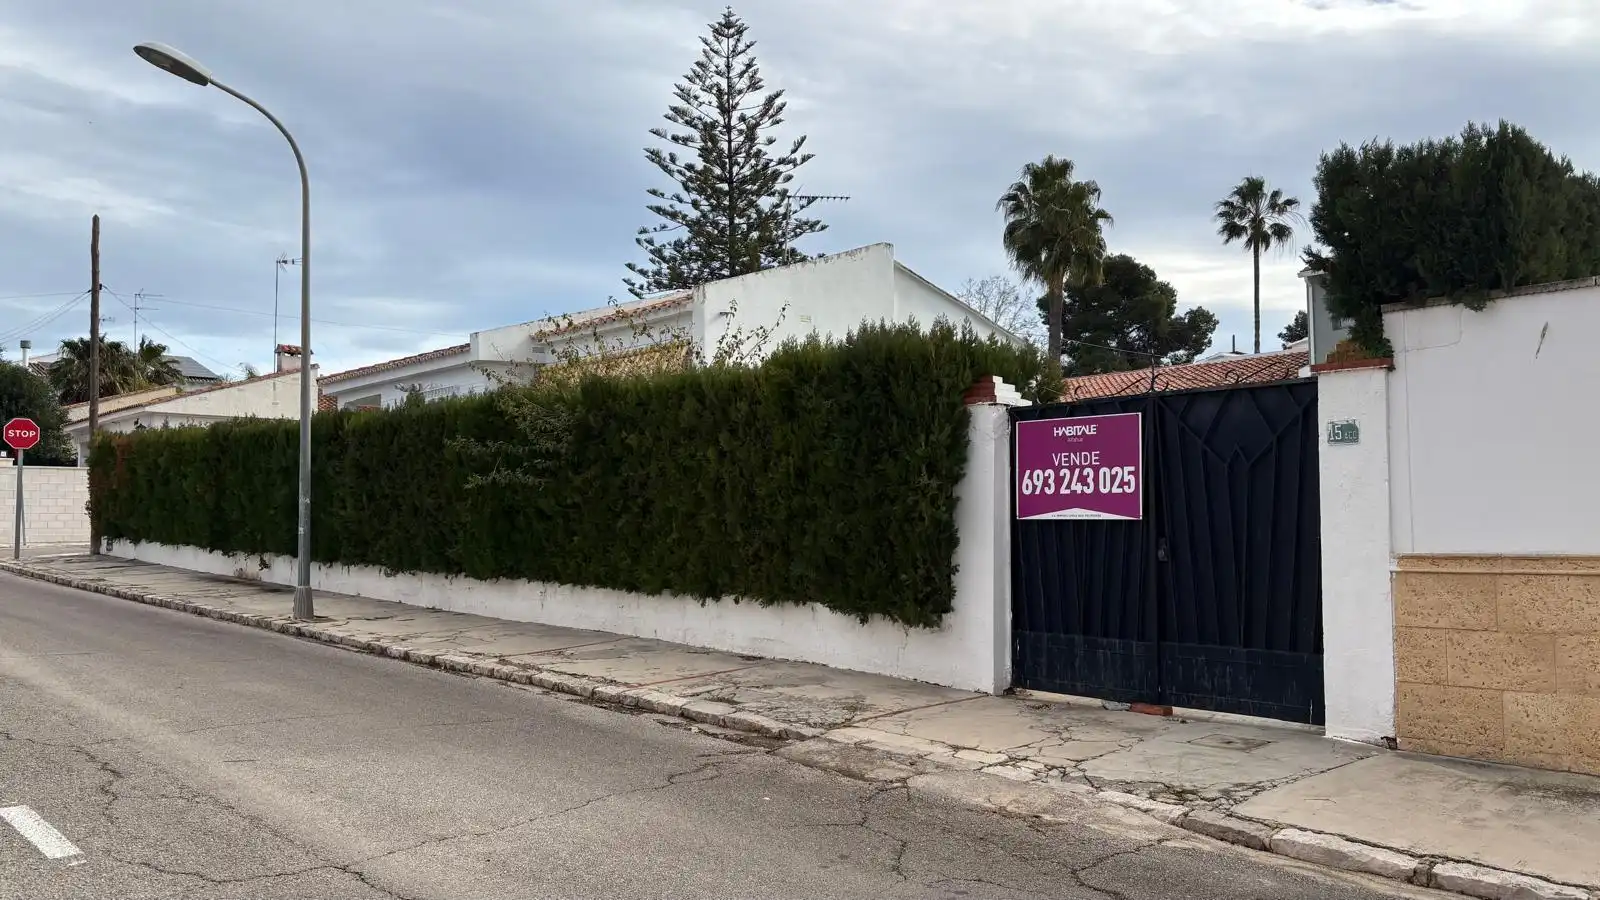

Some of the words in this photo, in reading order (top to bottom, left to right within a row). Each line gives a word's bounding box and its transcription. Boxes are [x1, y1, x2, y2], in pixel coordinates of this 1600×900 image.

[8, 429, 36, 438] STOP
[1053, 424, 1097, 437] HABITALE
[1328, 424, 1342, 440] 15
[1052, 451, 1100, 466] VENDE
[1021, 468, 1056, 495] 693
[1059, 467, 1095, 495] 243
[1098, 466, 1136, 494] 025
